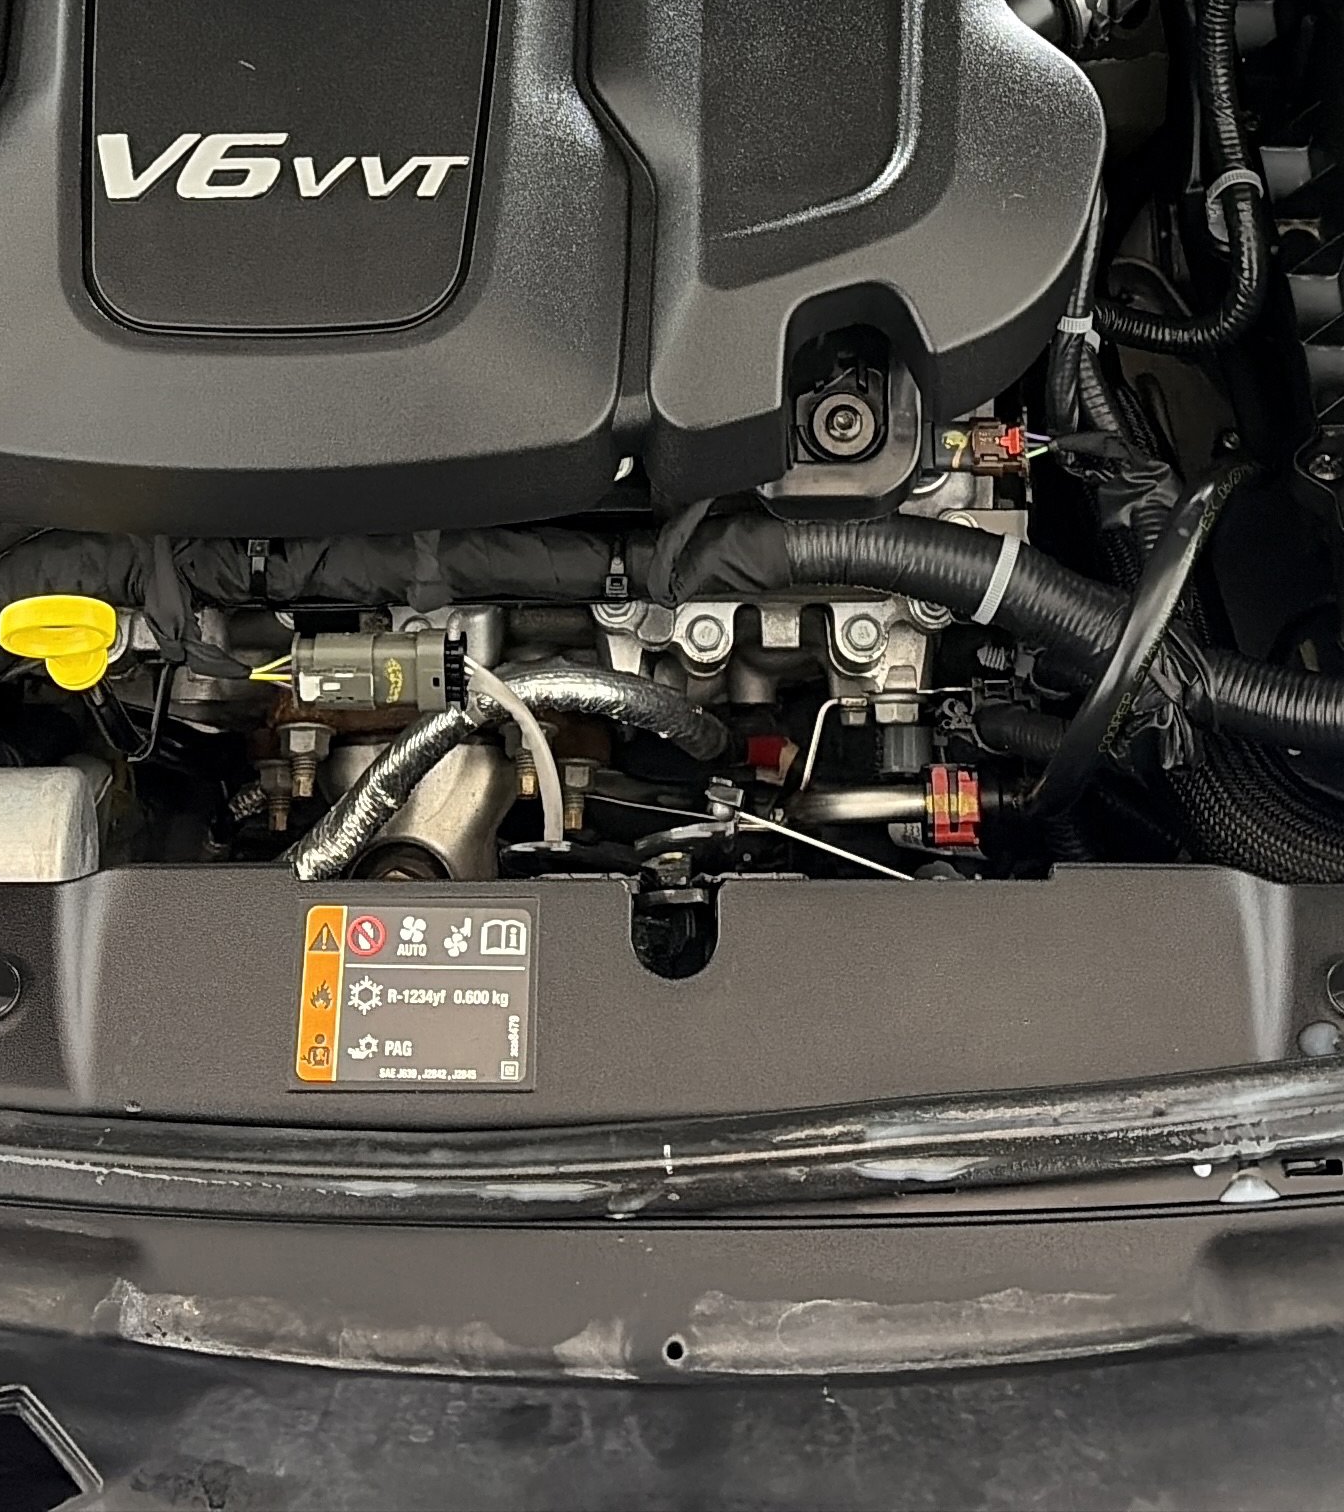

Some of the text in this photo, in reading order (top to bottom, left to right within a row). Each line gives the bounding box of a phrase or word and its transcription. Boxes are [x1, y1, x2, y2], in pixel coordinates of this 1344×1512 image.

[97, 133, 469, 200] V6 VVT
[396, 943, 427, 957] AUTO
[387, 989, 509, 1008] R-1234yf 0.600 kg
[384, 1041, 413, 1057] PAG
[379, 1067, 397, 1078] SAE
